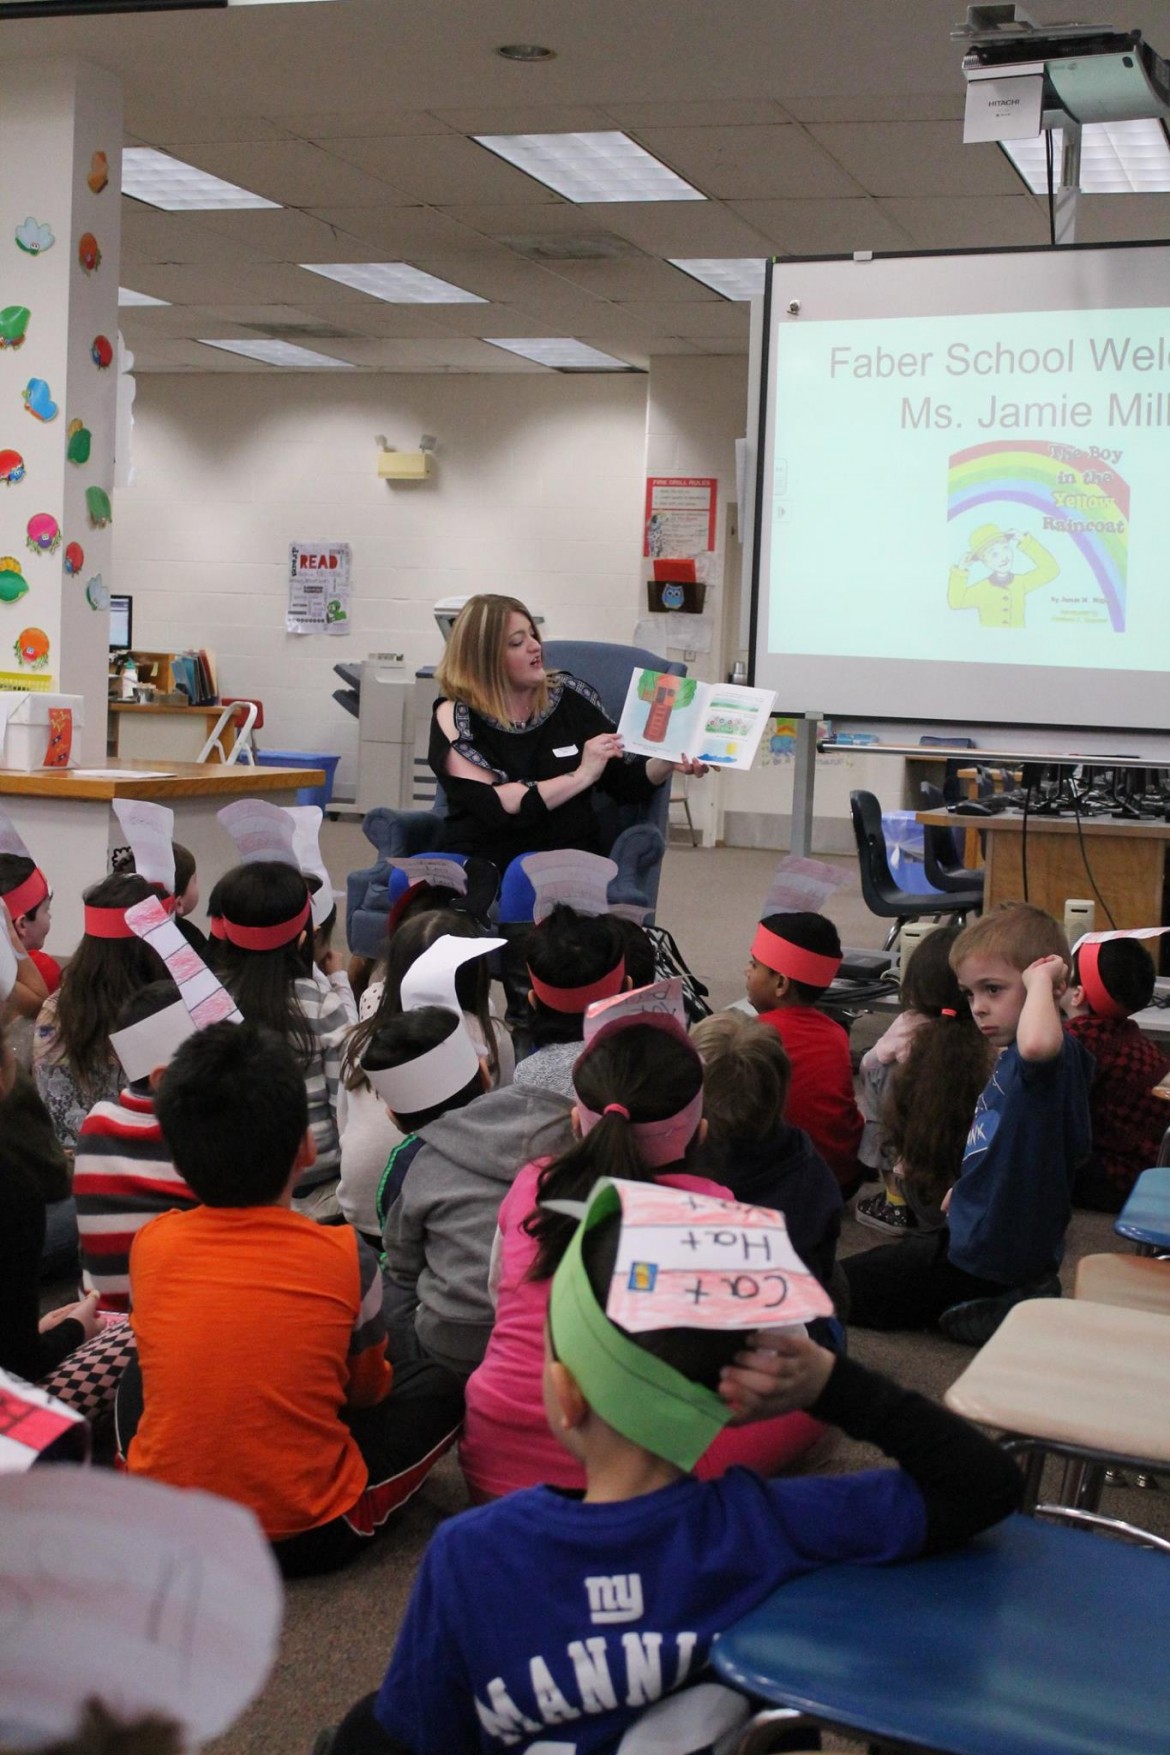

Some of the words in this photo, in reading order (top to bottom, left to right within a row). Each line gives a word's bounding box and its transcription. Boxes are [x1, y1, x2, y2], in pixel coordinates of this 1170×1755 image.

[988, 99, 1020, 107] HITACHI
[830, 345, 933, 378] Faber
[945, 340, 1075, 376] School
[1089, 337, 1170, 371] Wel
[901, 396, 962, 429] Ms.
[978, 394, 1092, 427] Jamie
[1050, 445, 1081, 460] The
[1089, 445, 1123, 464] Boy
[1057, 471, 1076, 484] in
[1083, 470, 1112, 484] the
[1053, 491, 1116, 508] Yellow
[1042, 516, 1125, 533] Raincoat
[300, 555, 338, 569] READ
[681, 1230, 772, 1261] Hat
[684, 1275, 788, 1308] Cat
